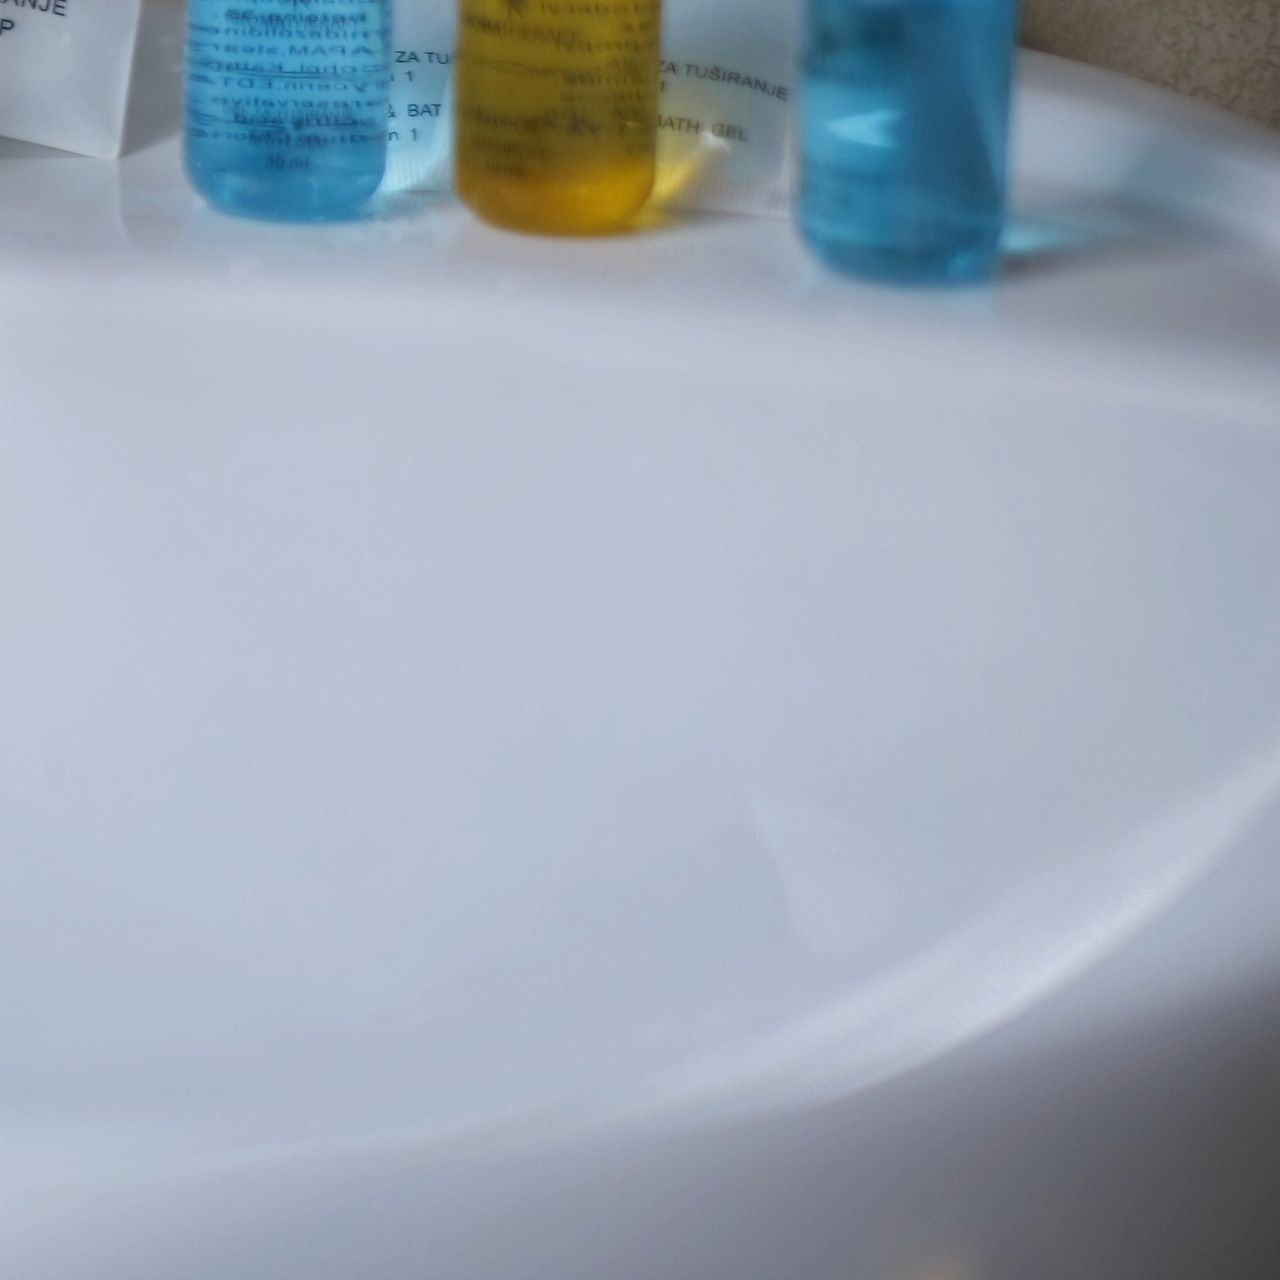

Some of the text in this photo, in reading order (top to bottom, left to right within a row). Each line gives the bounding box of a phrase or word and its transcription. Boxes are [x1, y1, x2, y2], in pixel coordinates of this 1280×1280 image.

[394, 50, 450, 65] ZA TU
[683, 64, 790, 102] TUŠIRANJE
[407, 103, 442, 117] BAT
[657, 114, 700, 134] ATH
